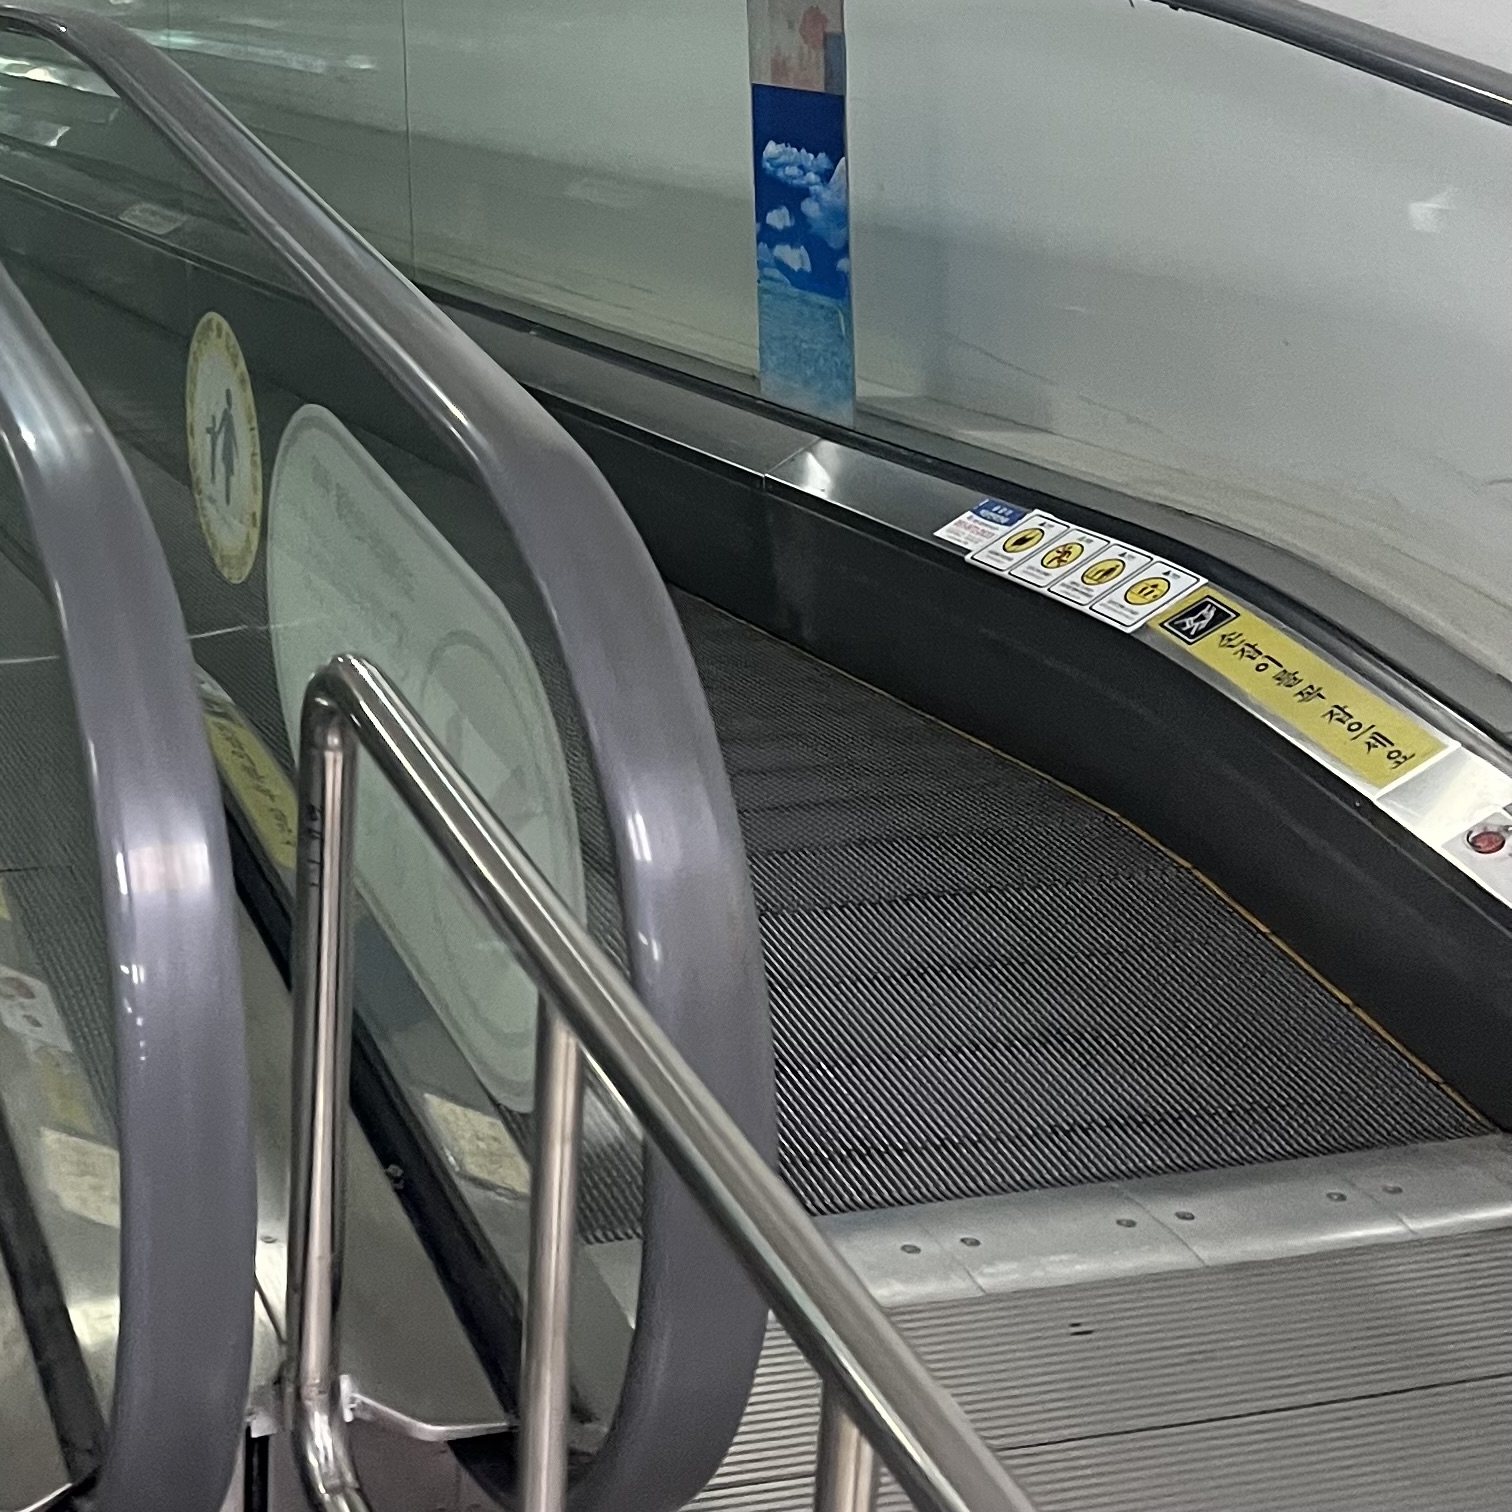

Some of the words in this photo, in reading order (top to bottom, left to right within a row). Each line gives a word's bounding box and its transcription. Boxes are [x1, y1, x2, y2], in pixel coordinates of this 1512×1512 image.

[1218, 631, 1304, 688] 손잡이를
[1292, 684, 1327, 704] 꼭
[1320, 704, 1417, 770] 잡으세요
